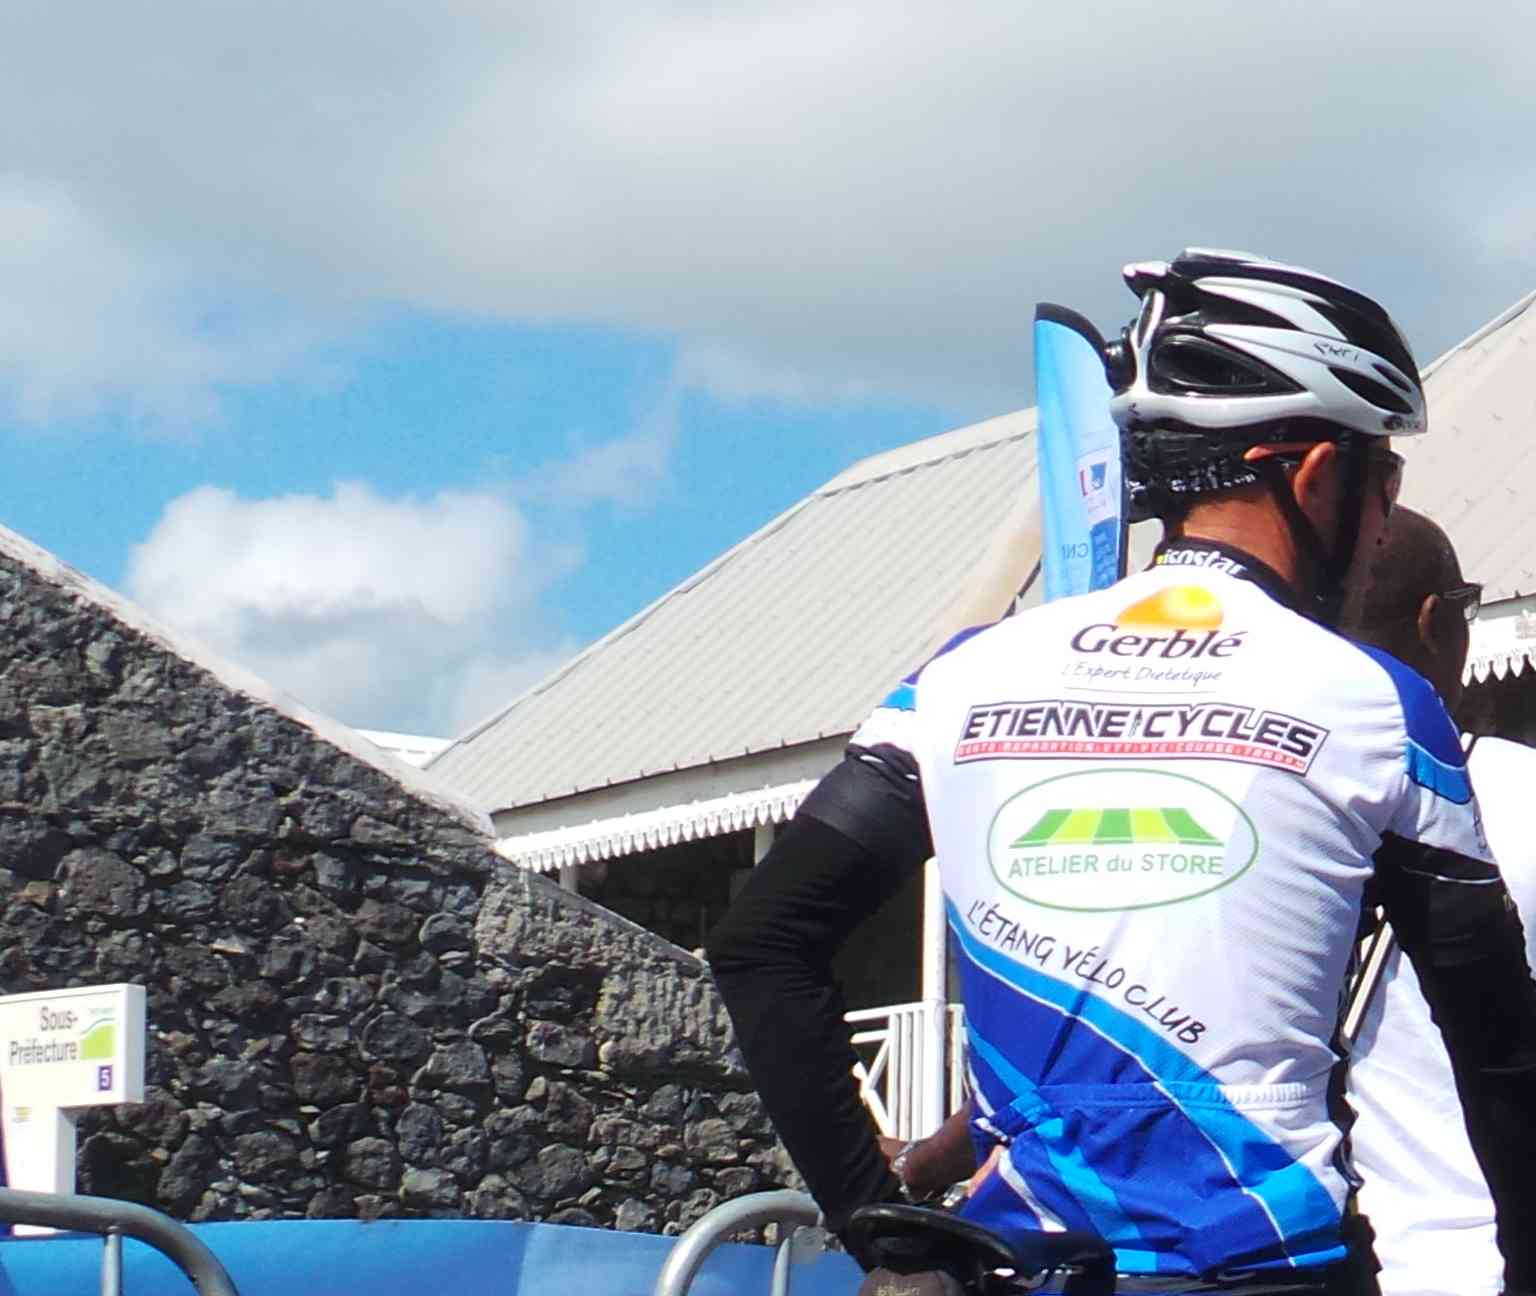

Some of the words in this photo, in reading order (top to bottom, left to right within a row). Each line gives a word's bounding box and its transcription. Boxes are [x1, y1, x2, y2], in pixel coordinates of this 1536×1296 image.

[1070, 623, 1249, 659] Gerblé
[963, 706, 1131, 740] ETIENNE
[1142, 708, 1319, 758] CYCLES
[1008, 854, 1099, 879] ATELIER
[1106, 855, 1133, 872] du
[1140, 853, 1224, 876] STORE
[967, 899, 1057, 966] L'ÉTANG
[1063, 946, 1127, 989] VÉLO
[1123, 985, 1208, 1045] CLUB
[40, 1006, 79, 1031] Sous-
[10, 1038, 78, 1066] Préfecture
